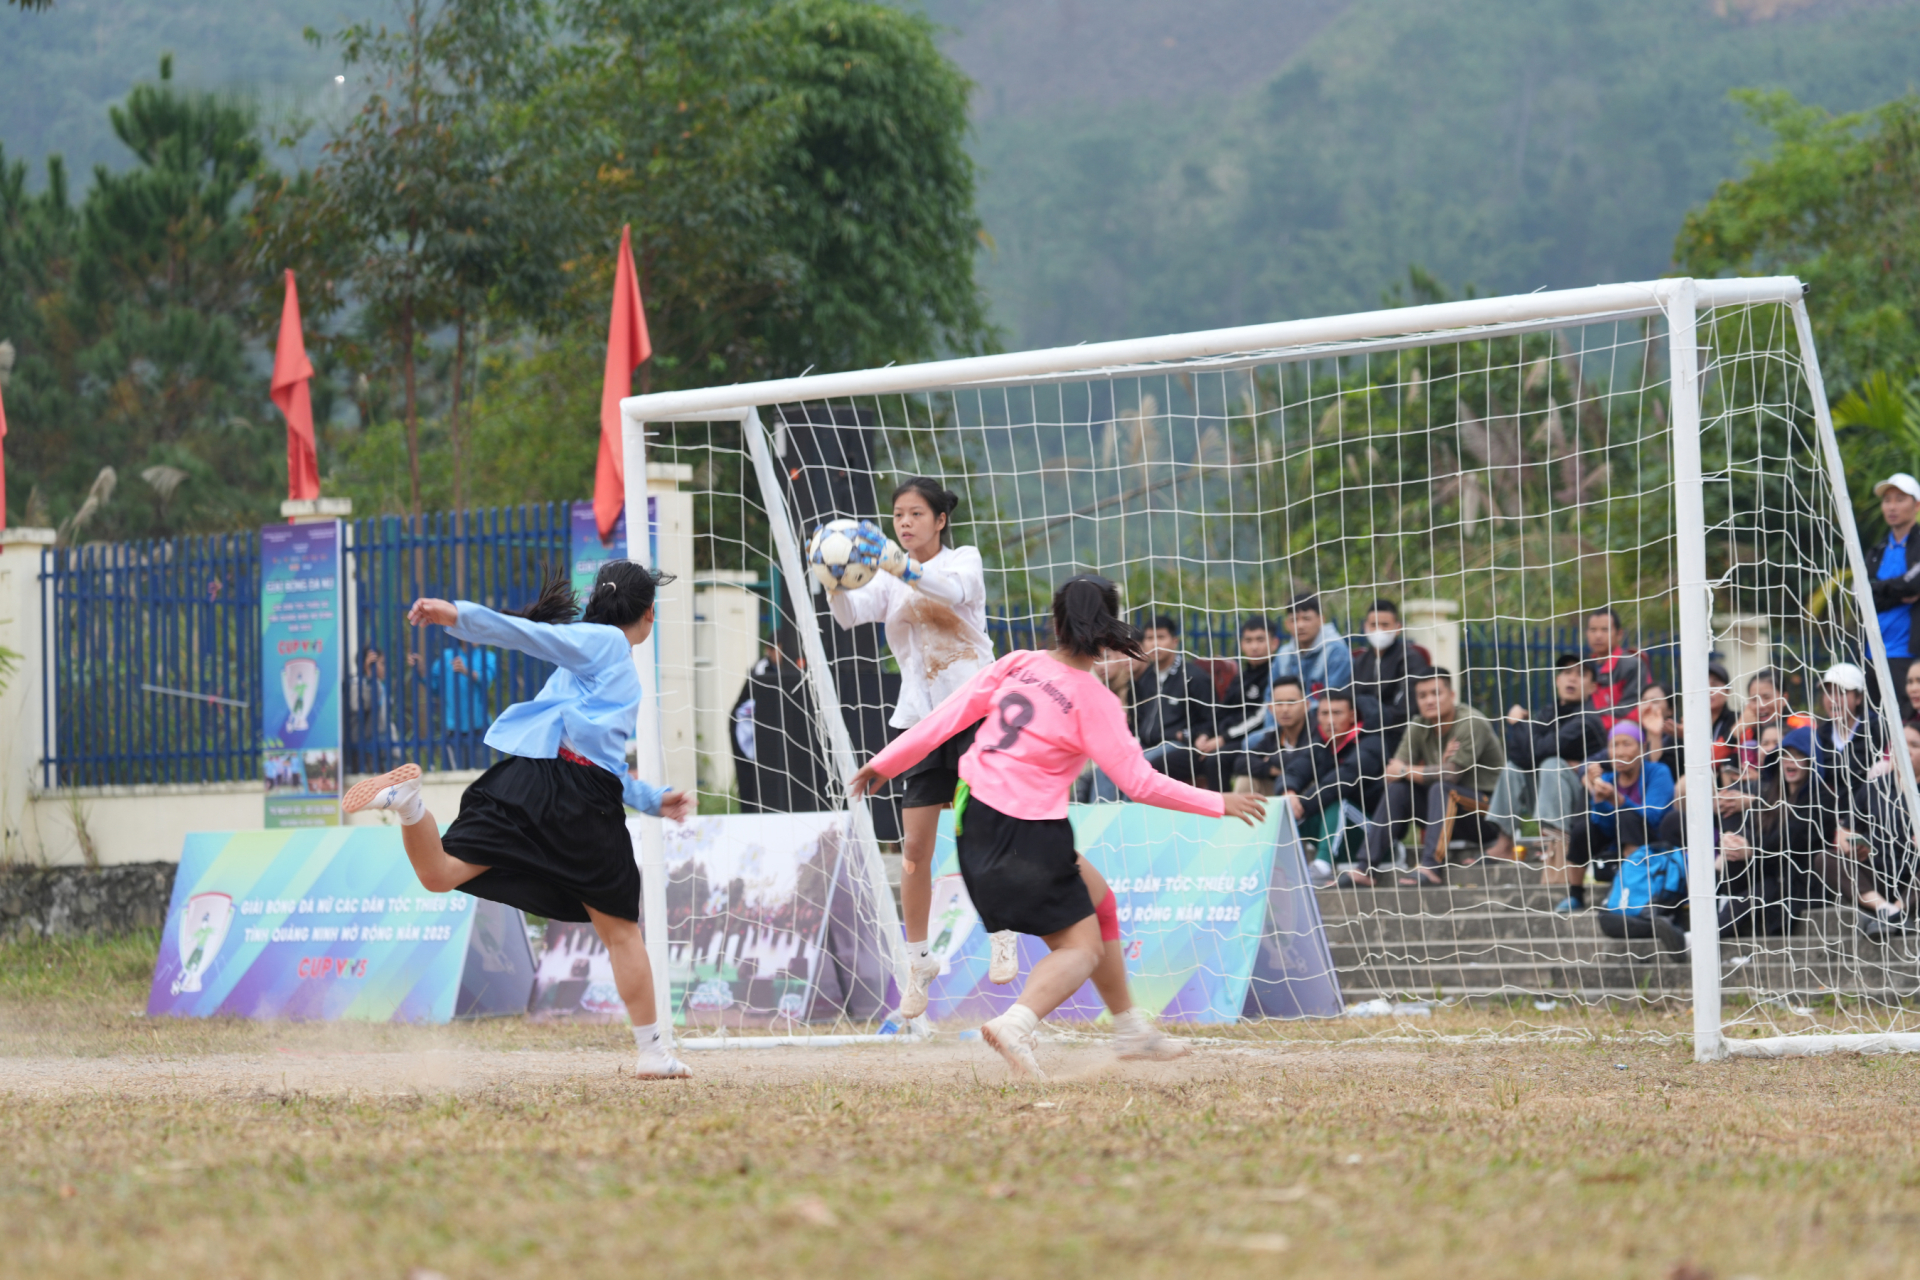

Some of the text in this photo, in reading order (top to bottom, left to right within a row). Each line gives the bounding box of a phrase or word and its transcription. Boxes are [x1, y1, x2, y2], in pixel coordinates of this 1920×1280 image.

[277, 638, 299, 656] CUP
[981, 691, 1036, 753] 9
[1133, 873, 1162, 893] DÂN
[1164, 873, 1192, 895] TỘC
[1238, 870, 1260, 892] SỐ
[241, 896, 264, 915] GIẢI
[335, 894, 359, 914] CÁC
[388, 893, 412, 915] TỘC
[1134, 902, 1172, 925] RỘNG
[1175, 902, 1205, 922] NĂM
[1206, 905, 1242, 922] 2025
[271, 923, 310, 943] QUẢNG
[311, 926, 339, 942] NINH
[361, 922, 393, 945] RỘNG
[396, 921, 421, 942] NĂM
[422, 925, 451, 942] 2025
[297, 956, 368, 979] CUP VTV5
